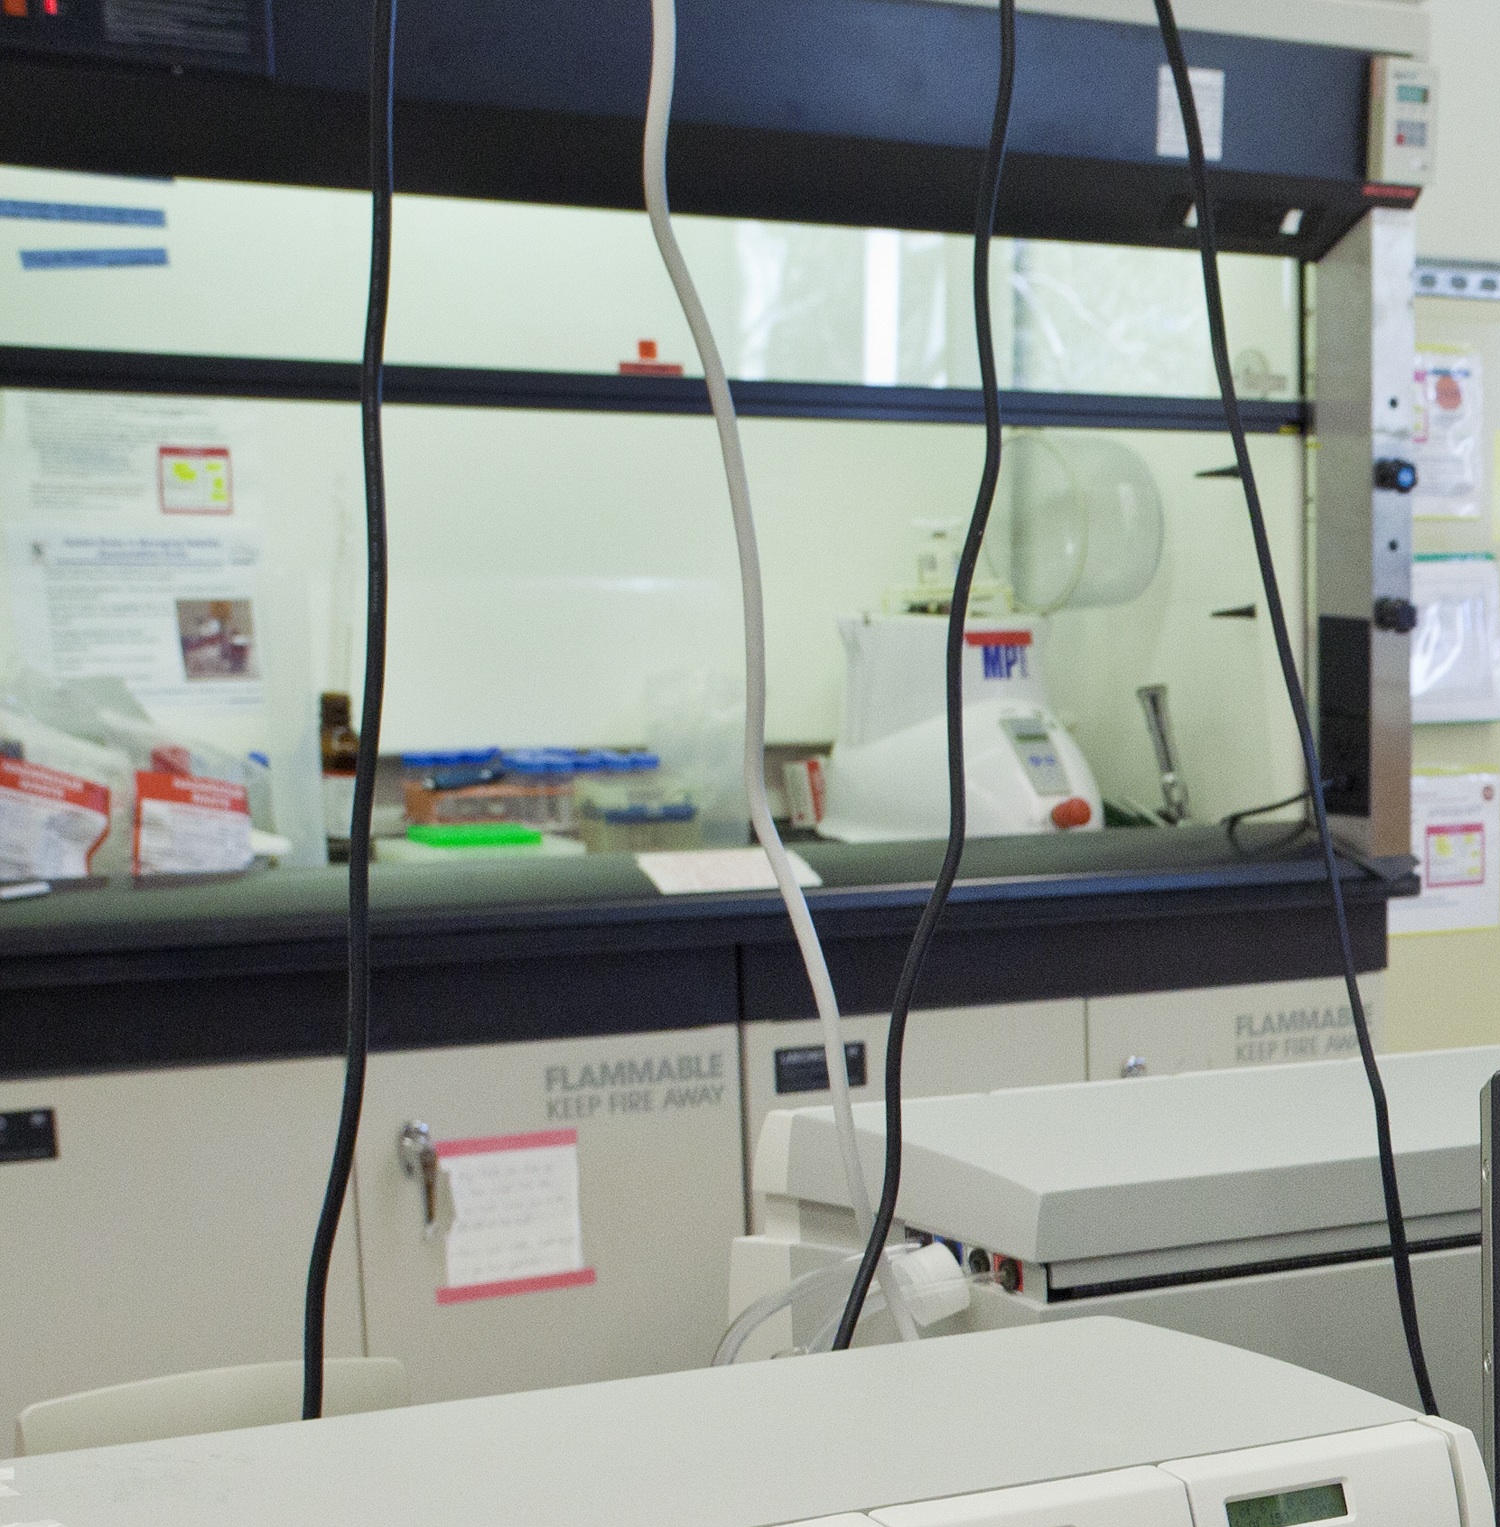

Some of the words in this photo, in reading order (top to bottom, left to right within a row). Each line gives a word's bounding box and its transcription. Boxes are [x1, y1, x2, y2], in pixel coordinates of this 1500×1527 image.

[545, 1054, 724, 1092] FLAMMABLE
[547, 1090, 601, 1121] KEEP
[609, 1089, 654, 1115] FIRE
[664, 1084, 725, 1111] AWAY
